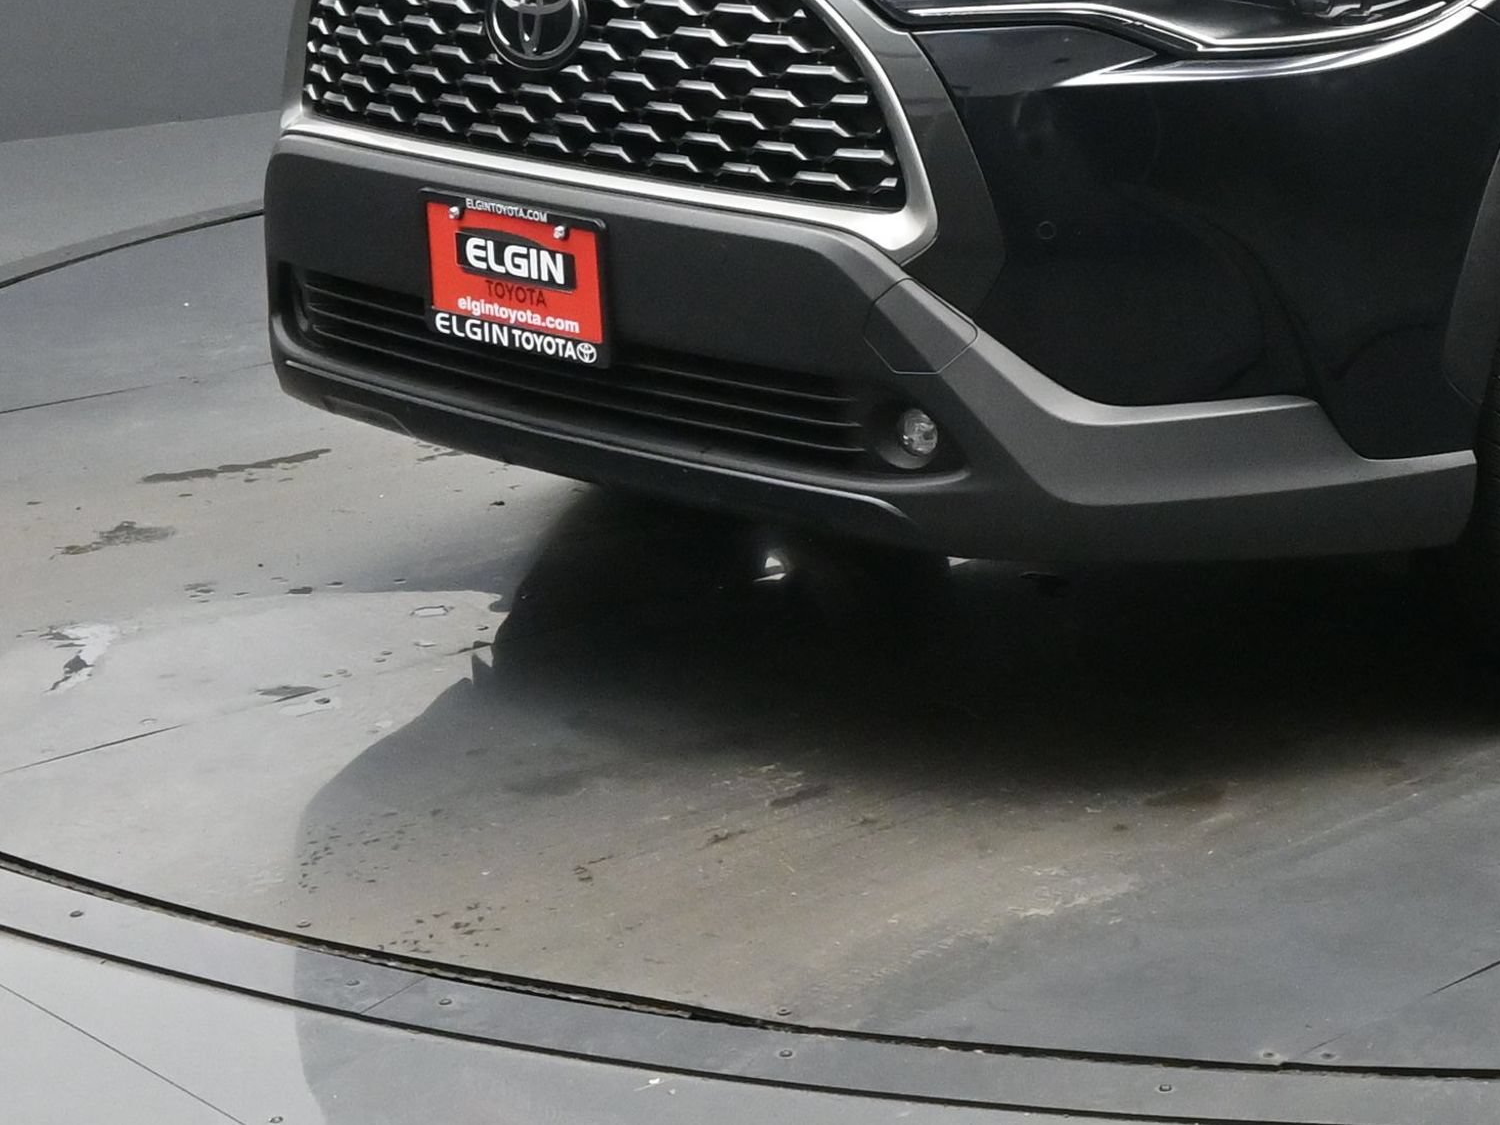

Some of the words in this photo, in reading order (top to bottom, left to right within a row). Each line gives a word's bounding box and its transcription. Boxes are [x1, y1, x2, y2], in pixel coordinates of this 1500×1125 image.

[465, 198, 548, 223] ELGINTOYOTA.COM
[465, 237, 565, 285] ELGIN
[485, 279, 547, 307] TOYOTA
[457, 296, 580, 333] elgintoyota.com
[435, 312, 509, 347] ELGIN
[511, 329, 577, 360] TOYOTA
